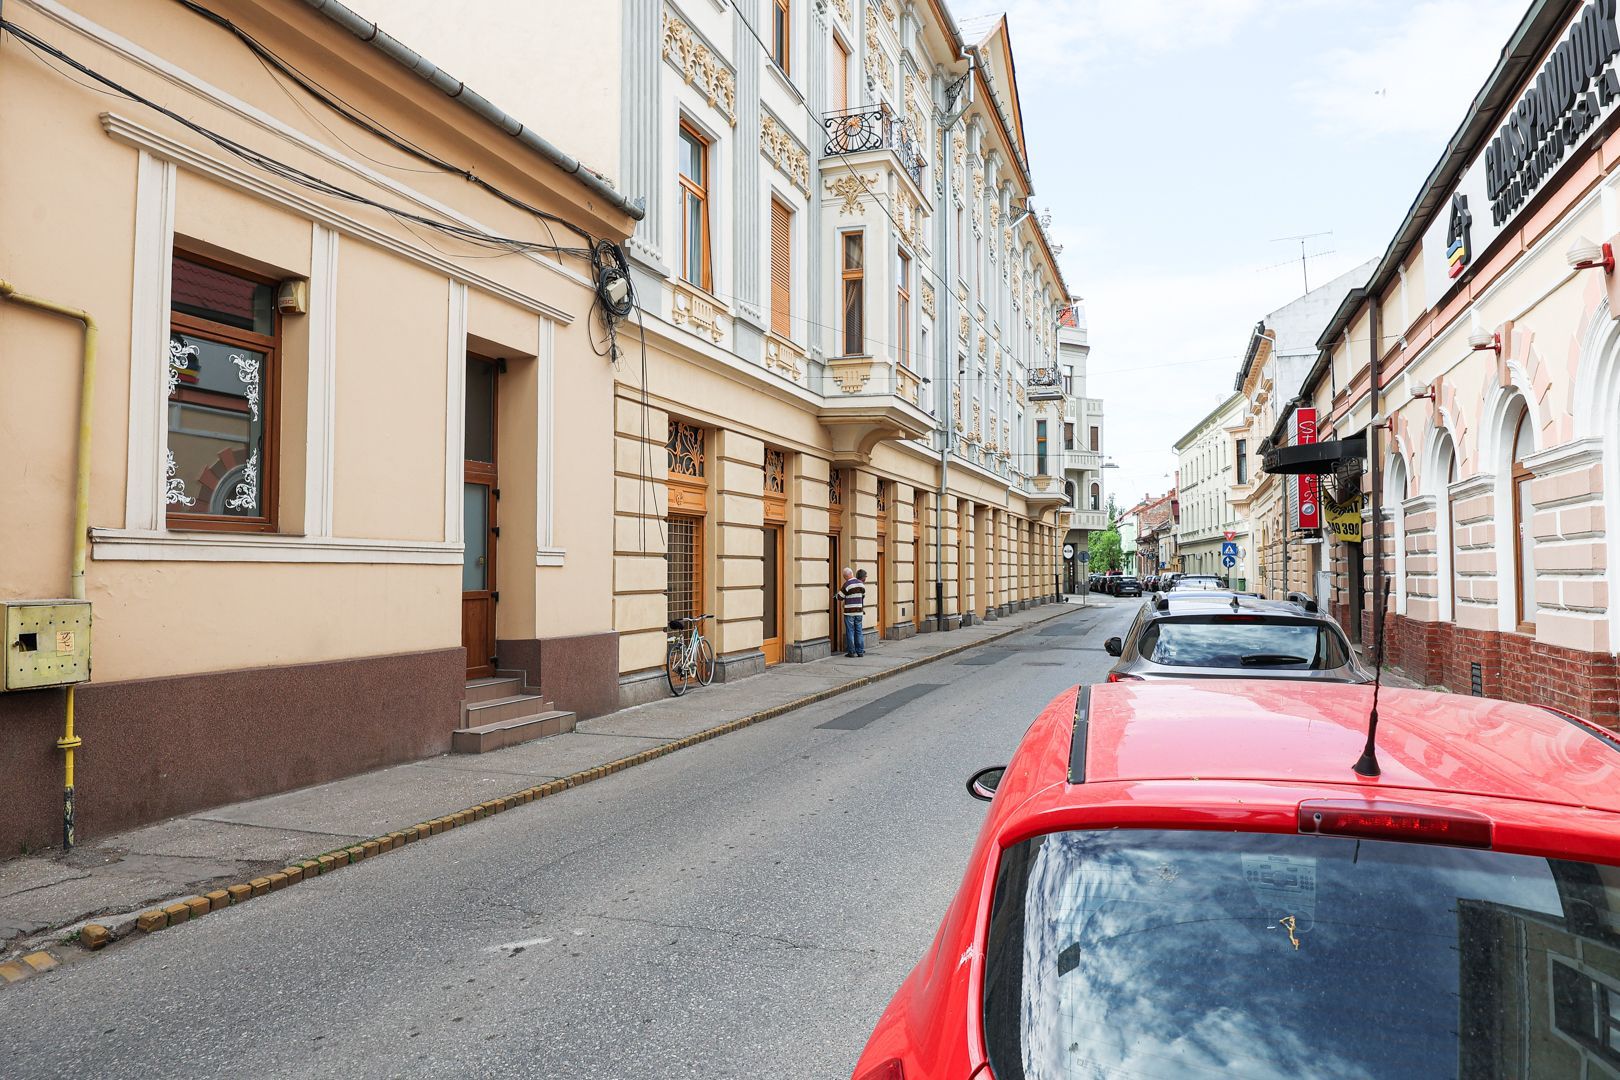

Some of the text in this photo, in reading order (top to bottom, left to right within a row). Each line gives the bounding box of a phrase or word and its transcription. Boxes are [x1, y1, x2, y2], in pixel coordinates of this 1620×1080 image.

[1485, 0, 1619, 201] GLASSPANDOOR
[1490, 181, 1524, 226] TOTUL
[1520, 129, 1564, 195] PENTRU
[1342, 523, 1360, 535] 390
